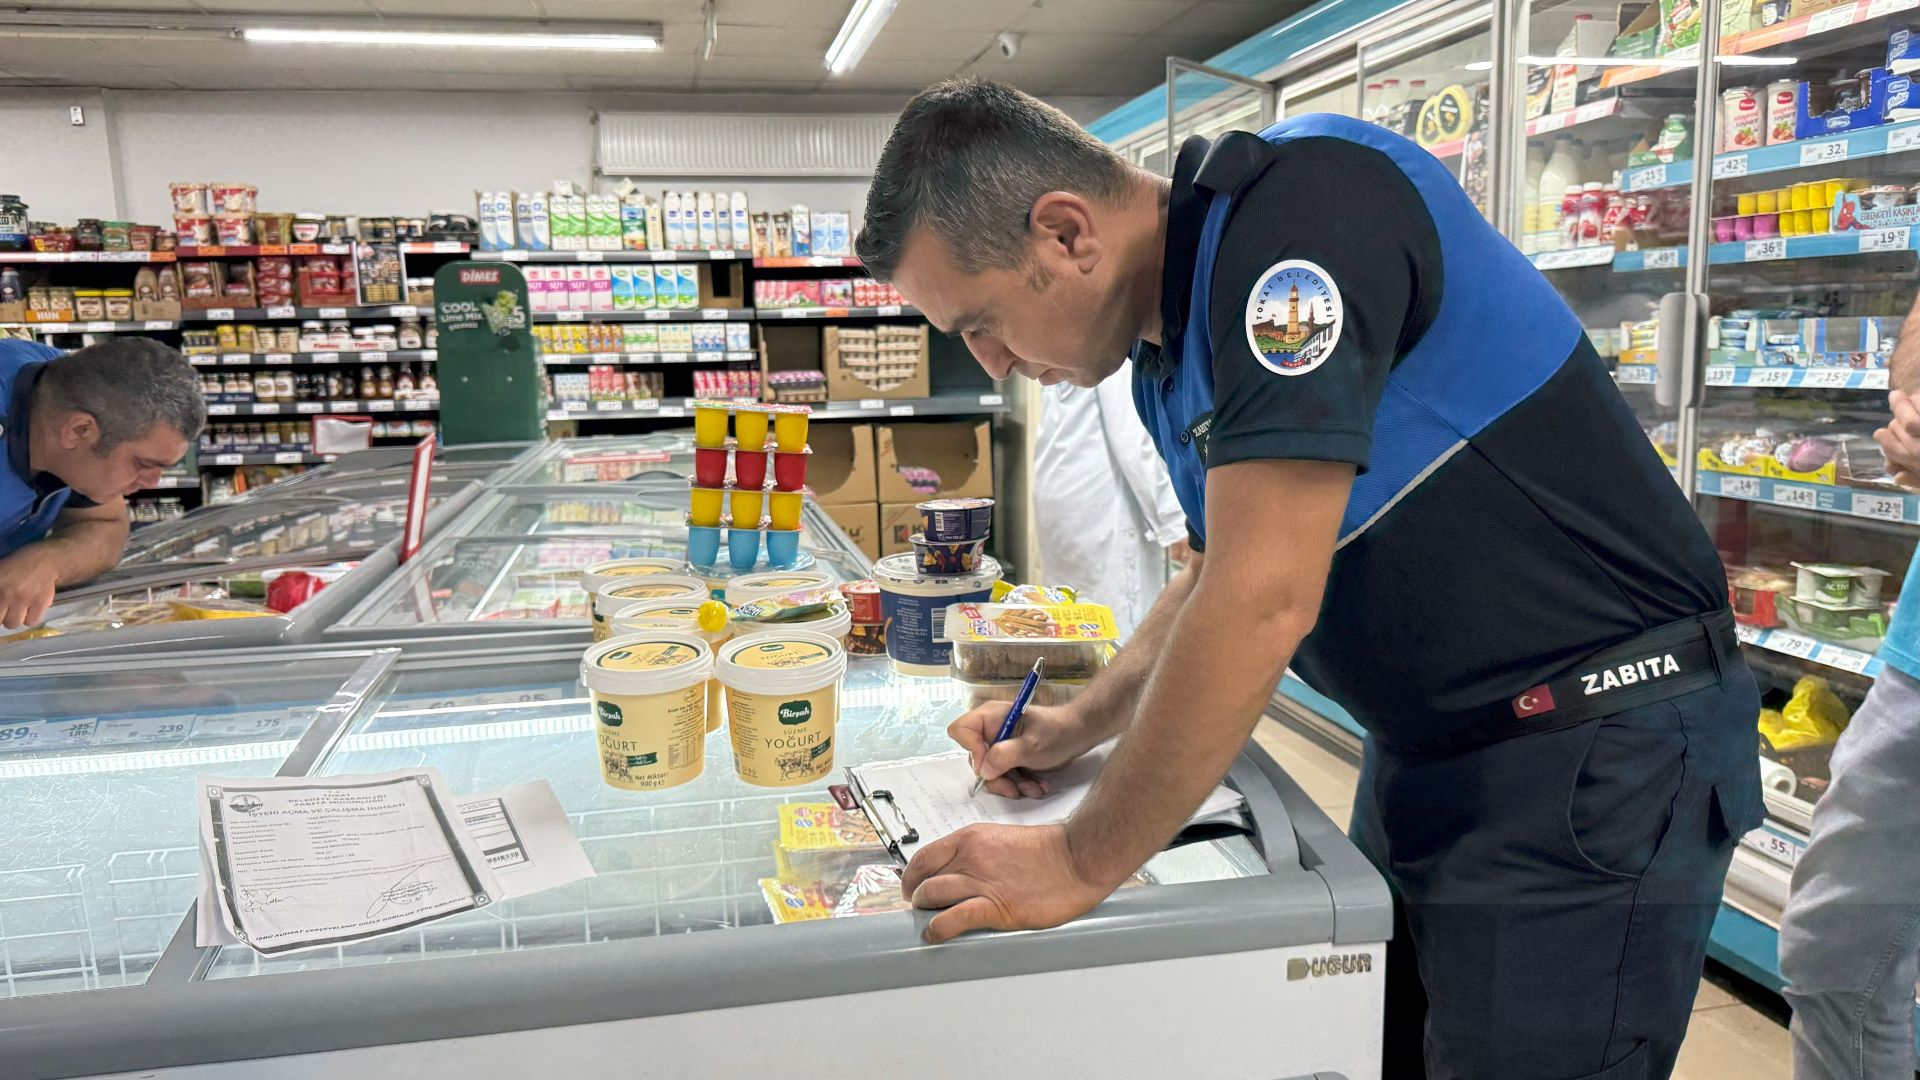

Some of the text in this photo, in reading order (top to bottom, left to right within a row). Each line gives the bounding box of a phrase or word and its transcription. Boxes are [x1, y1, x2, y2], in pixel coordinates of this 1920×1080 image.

[1827, 143, 1841, 156] 32
[1880, 231, 1894, 245] 19
[1762, 242, 1775, 254] 36
[462, 270, 498, 283] DİMES
[441, 301, 479, 313] COOL
[1257, 285, 1273, 320] TOKAT
[1877, 501, 1891, 513] 22
[1786, 639, 1801, 649] 79
[1581, 654, 1680, 696] ZABITA
[780, 706, 810, 719] Birşah
[158, 724, 183, 734] 239
[256, 718, 280, 728] 175
[0, 726, 29, 739] 89
[765, 730, 822, 749] YOĞURT
